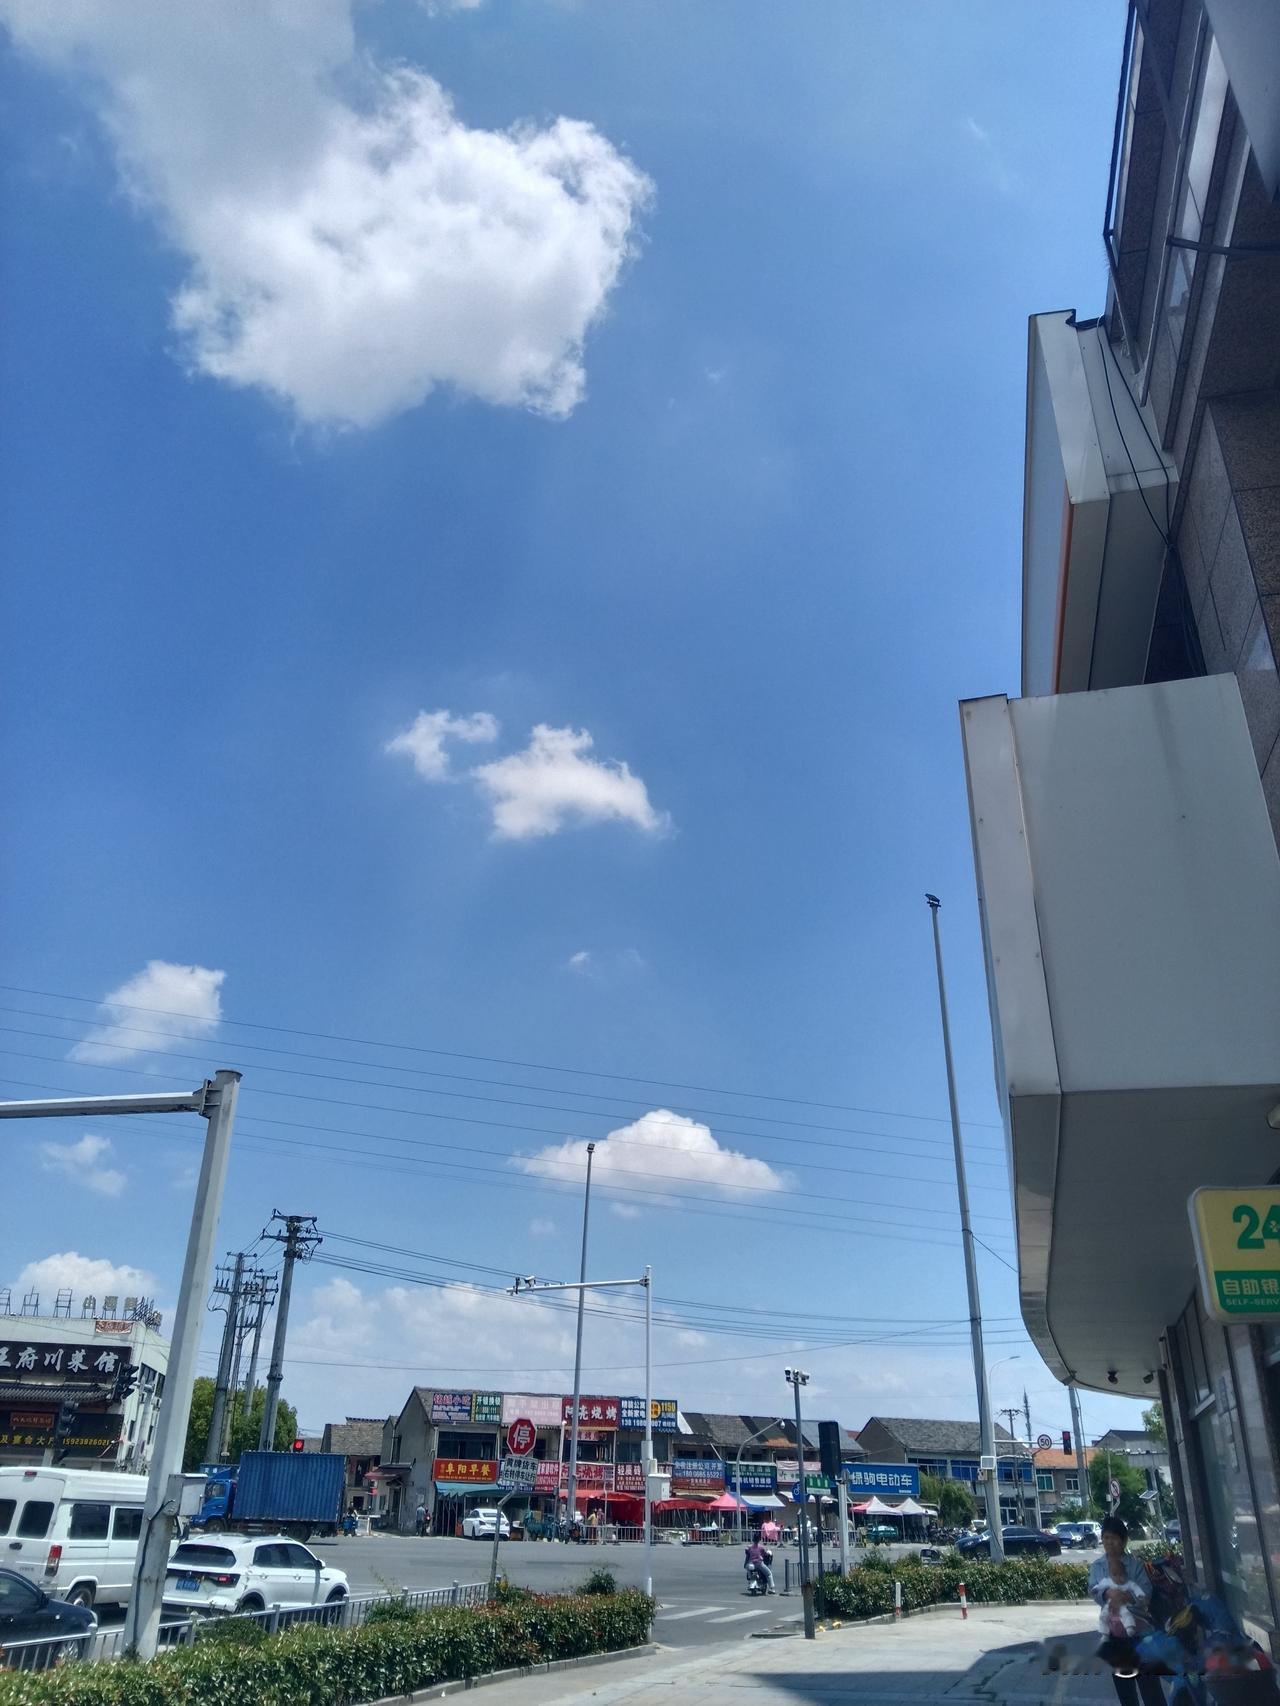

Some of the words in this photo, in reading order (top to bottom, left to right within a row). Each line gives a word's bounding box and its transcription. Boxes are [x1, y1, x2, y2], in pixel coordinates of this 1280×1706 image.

[513, 1424, 532, 1449] 停
[1040, 1438, 1050, 1447] 50
[445, 1462, 491, 1477] 阜阳早餐
[507, 1457, 537, 1472] 黄牌货车
[851, 1472, 913, 1487] 绿驹电动车
